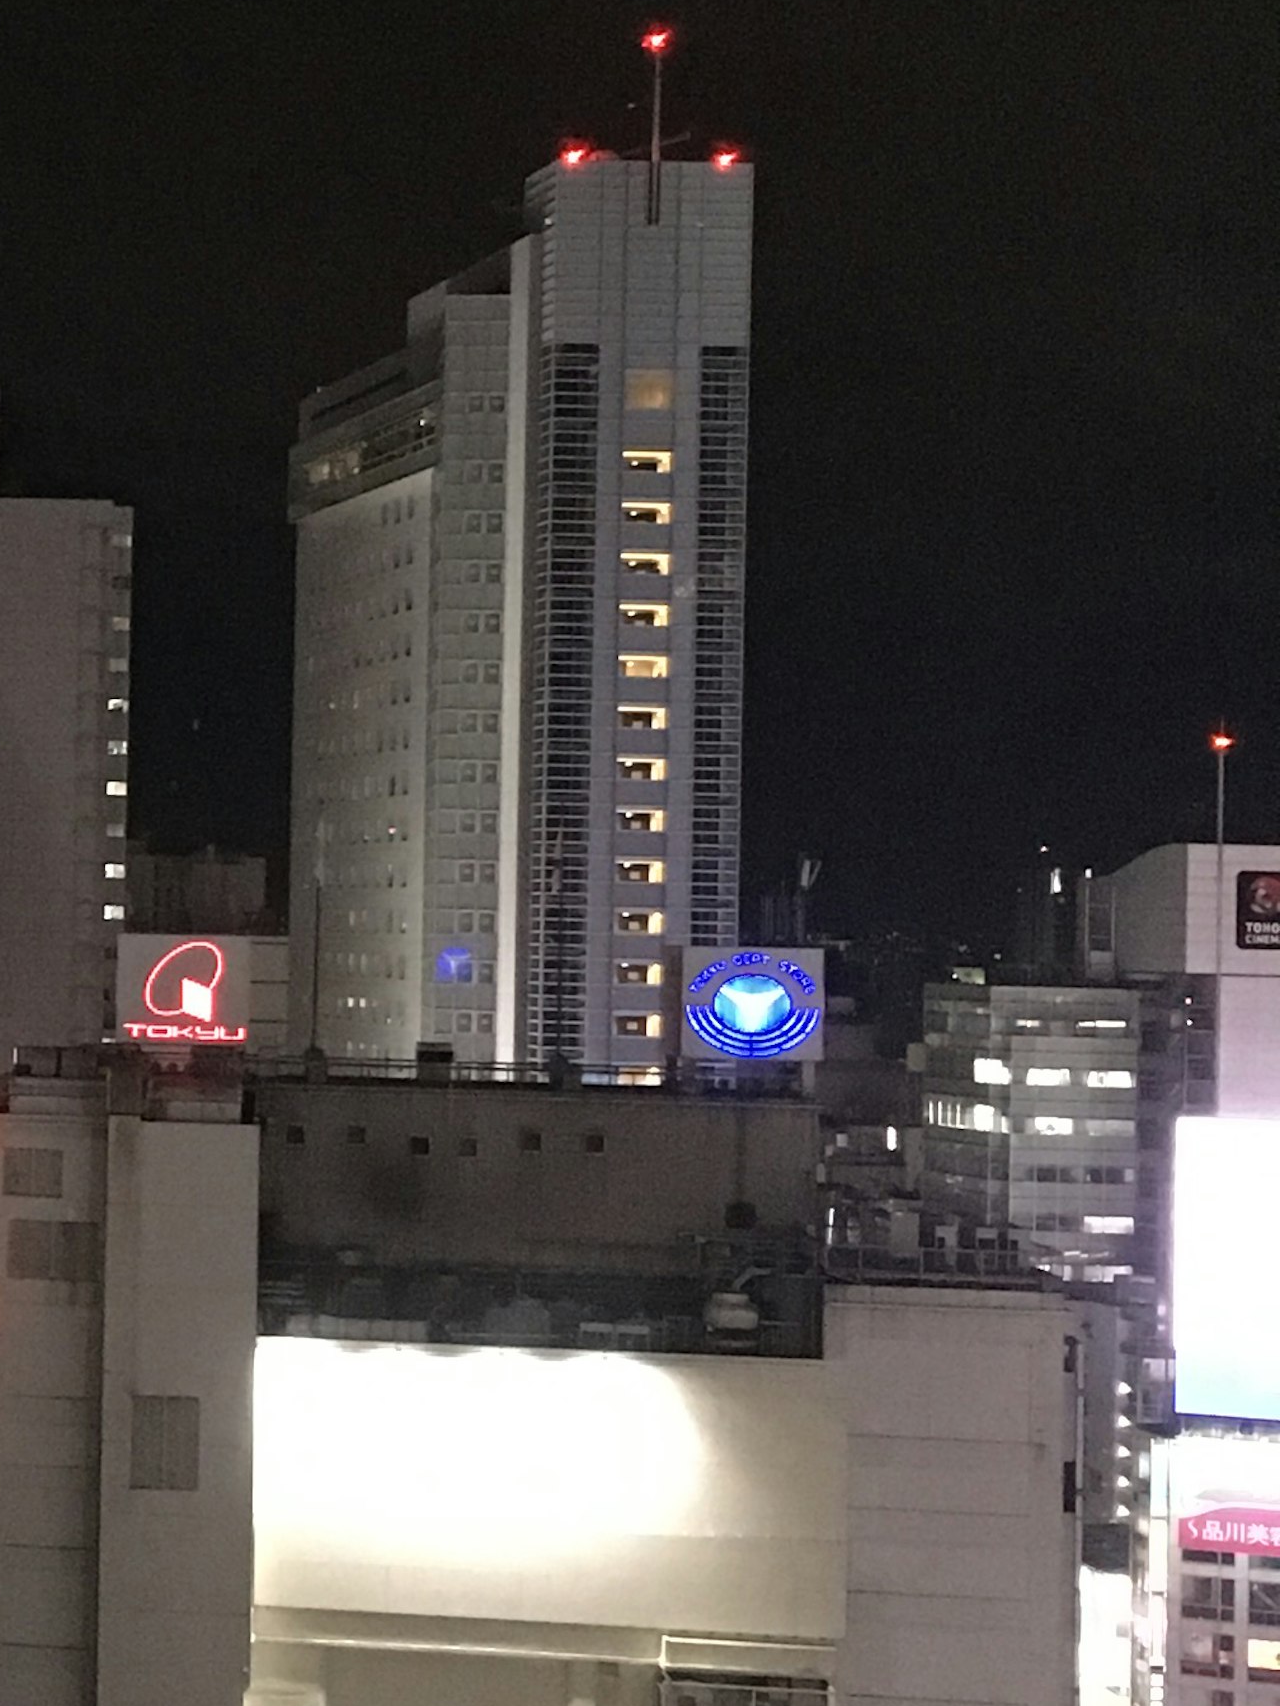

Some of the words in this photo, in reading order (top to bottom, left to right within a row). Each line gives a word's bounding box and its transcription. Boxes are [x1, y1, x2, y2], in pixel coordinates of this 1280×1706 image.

[1244, 921, 1280, 934] TOHO
[779, 960, 816, 994] STORE
[123, 1022, 247, 1041] TOKYU
